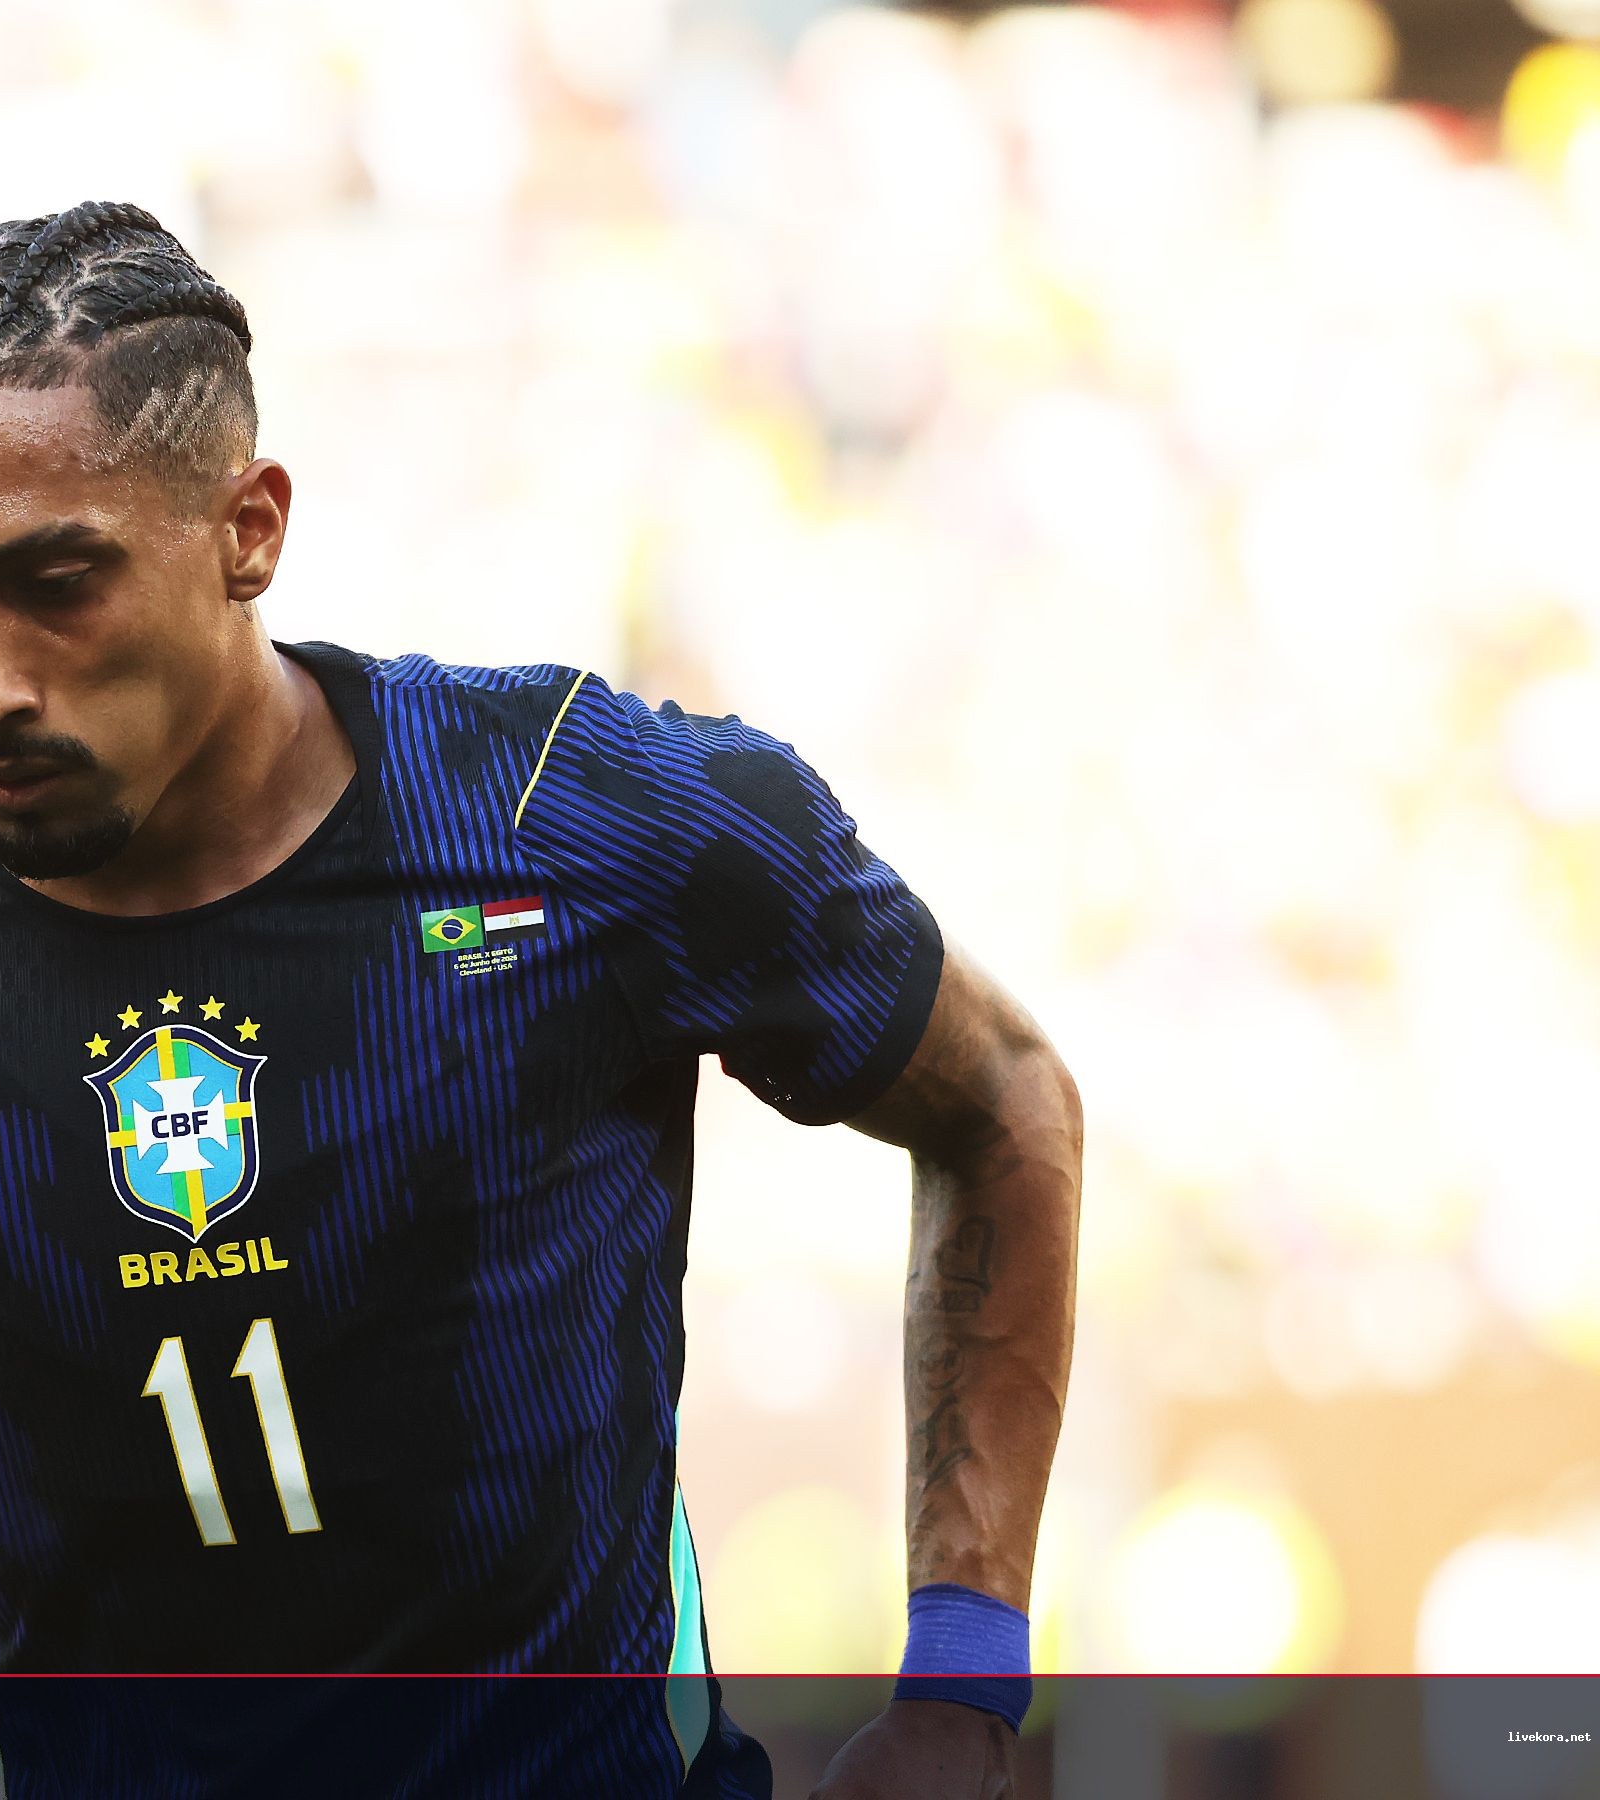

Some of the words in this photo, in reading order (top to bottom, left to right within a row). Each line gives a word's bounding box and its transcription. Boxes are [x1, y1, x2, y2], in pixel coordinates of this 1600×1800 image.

[458, 953, 484, 962] BRASIL
[491, 948, 513, 957] EGITO
[470, 959, 490, 968] Junho
[501, 954, 518, 962] 2026
[459, 966, 492, 976] Cleveland
[497, 963, 513, 971] USA
[151, 1110, 209, 1139] CBF
[119, 1237, 288, 1288] BRASIL
[141, 1318, 323, 1547] 11
